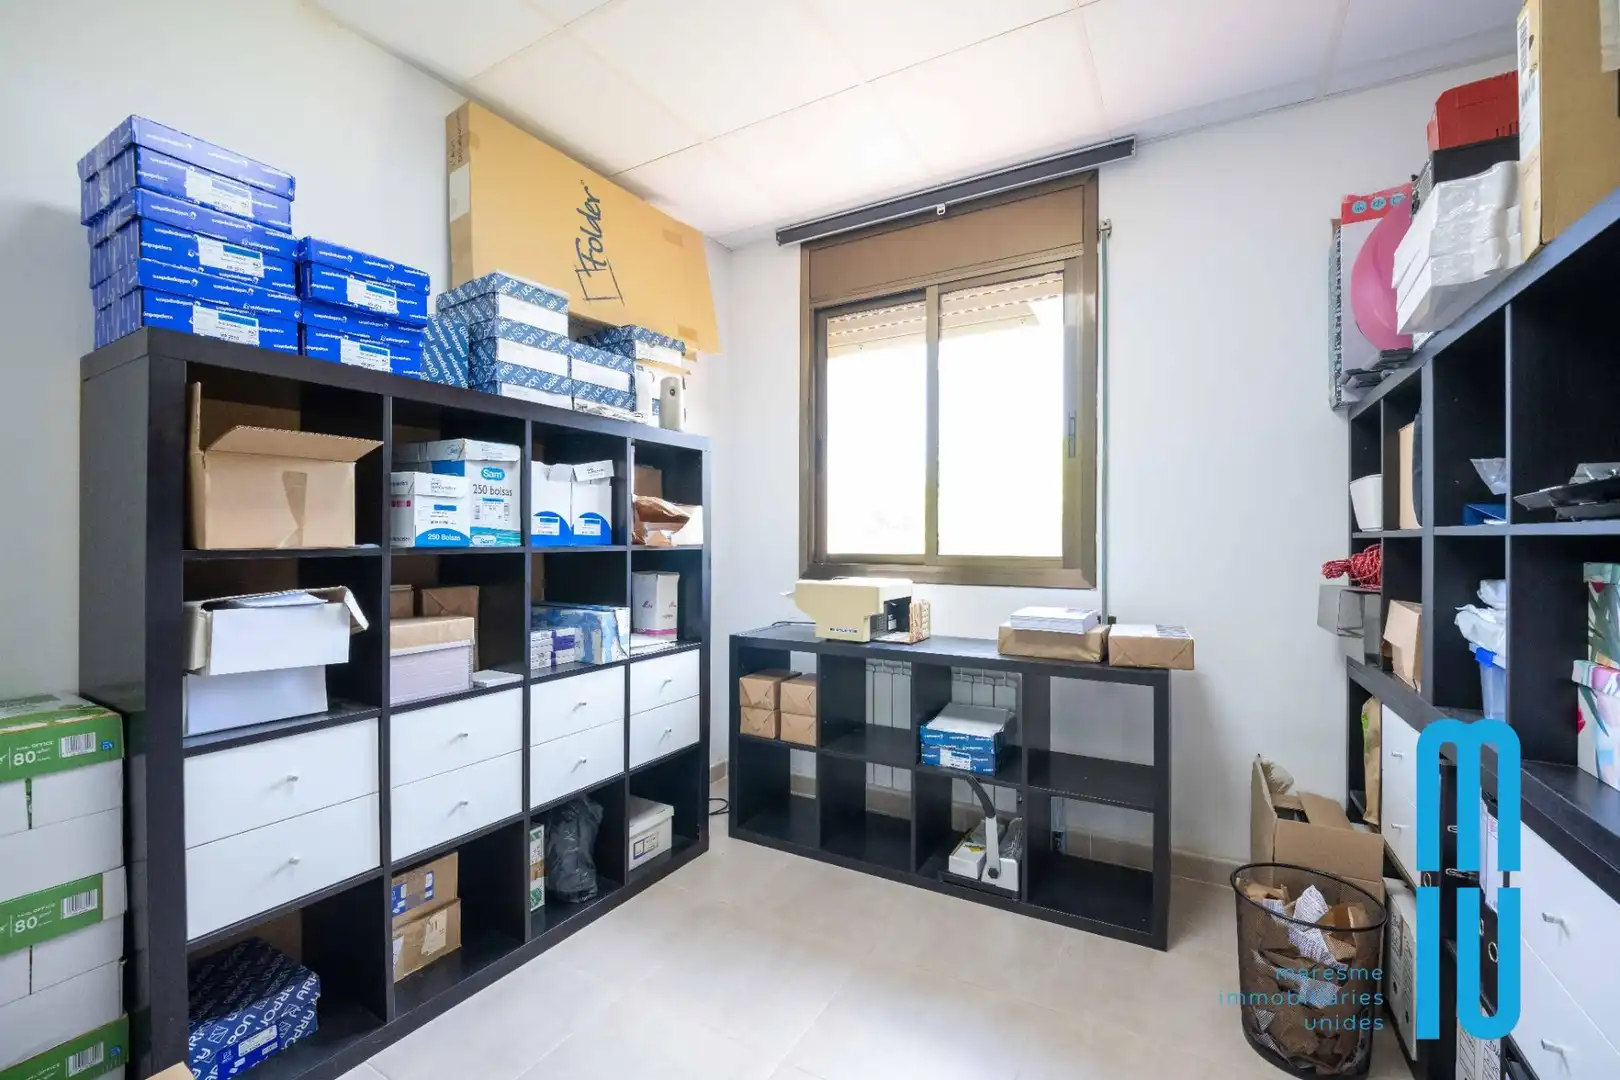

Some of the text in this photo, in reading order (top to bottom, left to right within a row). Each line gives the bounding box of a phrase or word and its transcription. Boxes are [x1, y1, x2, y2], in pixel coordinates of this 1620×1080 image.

[575, 186, 607, 278] Folder
[482, 468, 503, 479] Sam
[472, 483, 513, 497] 250 bolsas
[427, 533, 440, 541] 250
[13, 750, 37, 767] 80
[14, 915, 38, 934] 80
